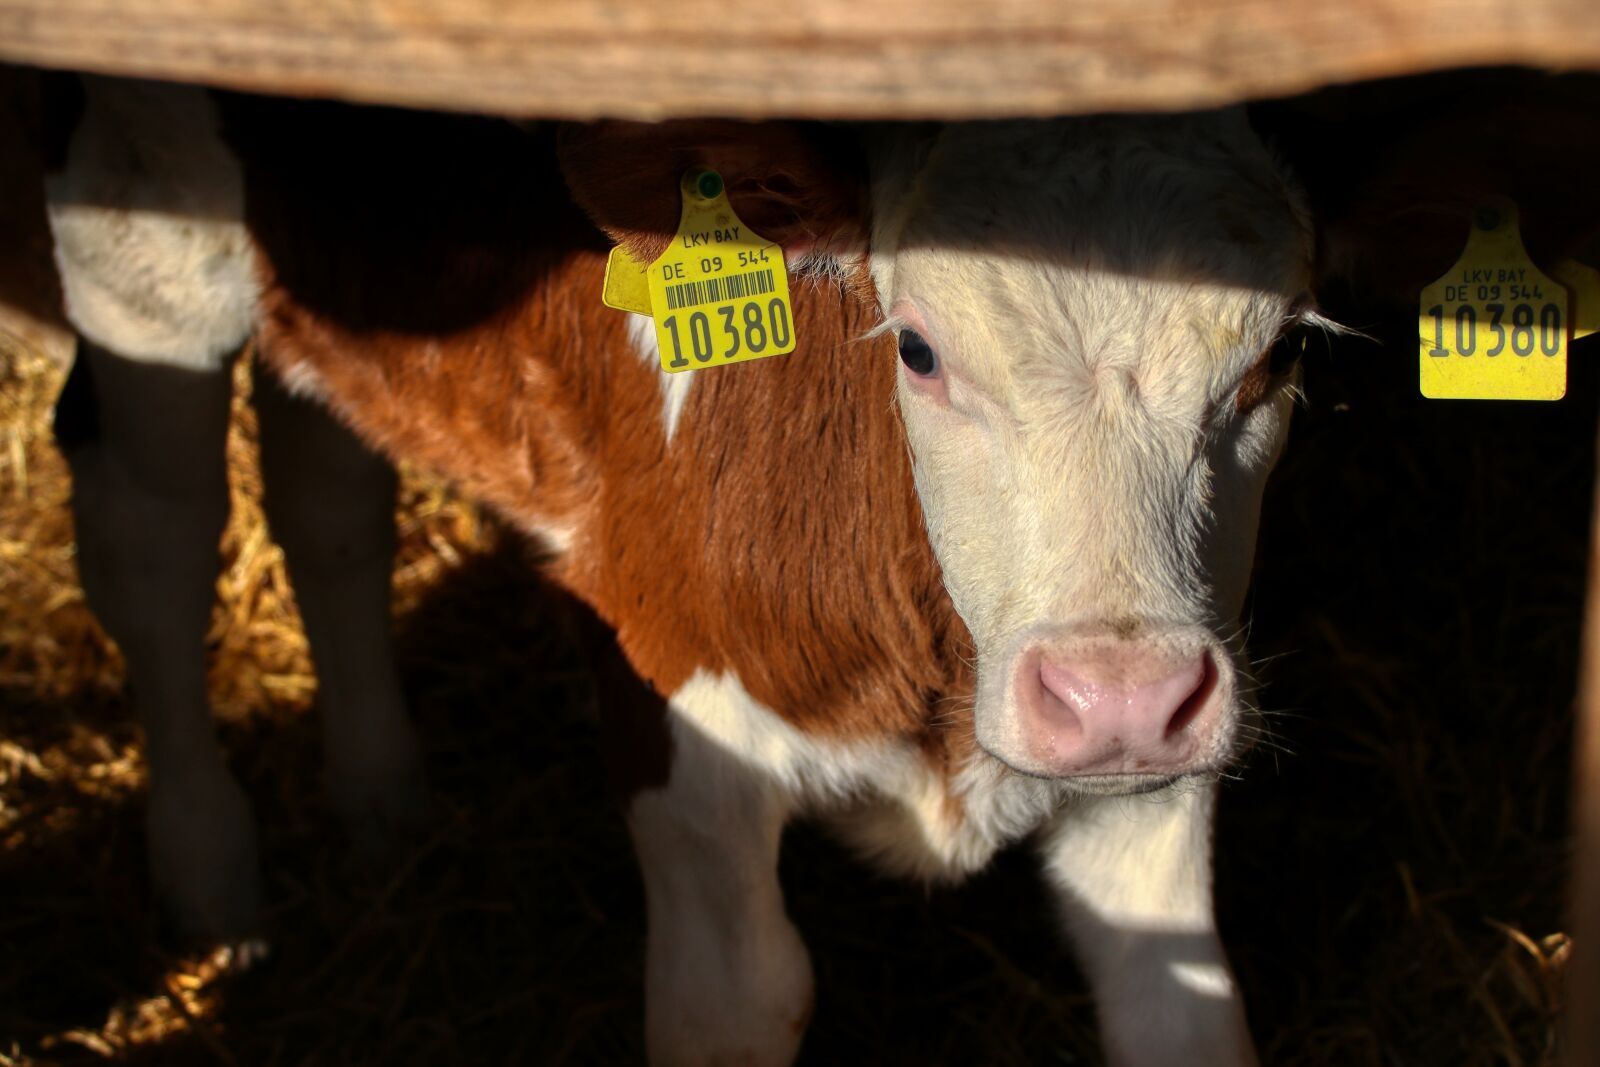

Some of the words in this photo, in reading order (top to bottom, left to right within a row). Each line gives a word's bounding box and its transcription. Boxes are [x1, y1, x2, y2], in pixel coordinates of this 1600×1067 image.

[683, 232, 710, 249] LKV
[715, 227, 740, 244] BAY
[662, 262, 685, 280] DE
[701, 256, 723, 273] 09
[738, 249, 770, 267] 544
[1463, 269, 1493, 284] LKV
[1498, 269, 1526, 282] BAY
[1445, 286, 1468, 301] DE
[1477, 285, 1500, 301] 09
[1509, 285, 1543, 300] 544
[663, 297, 791, 368] 10380
[1428, 303, 1561, 357] 10380
